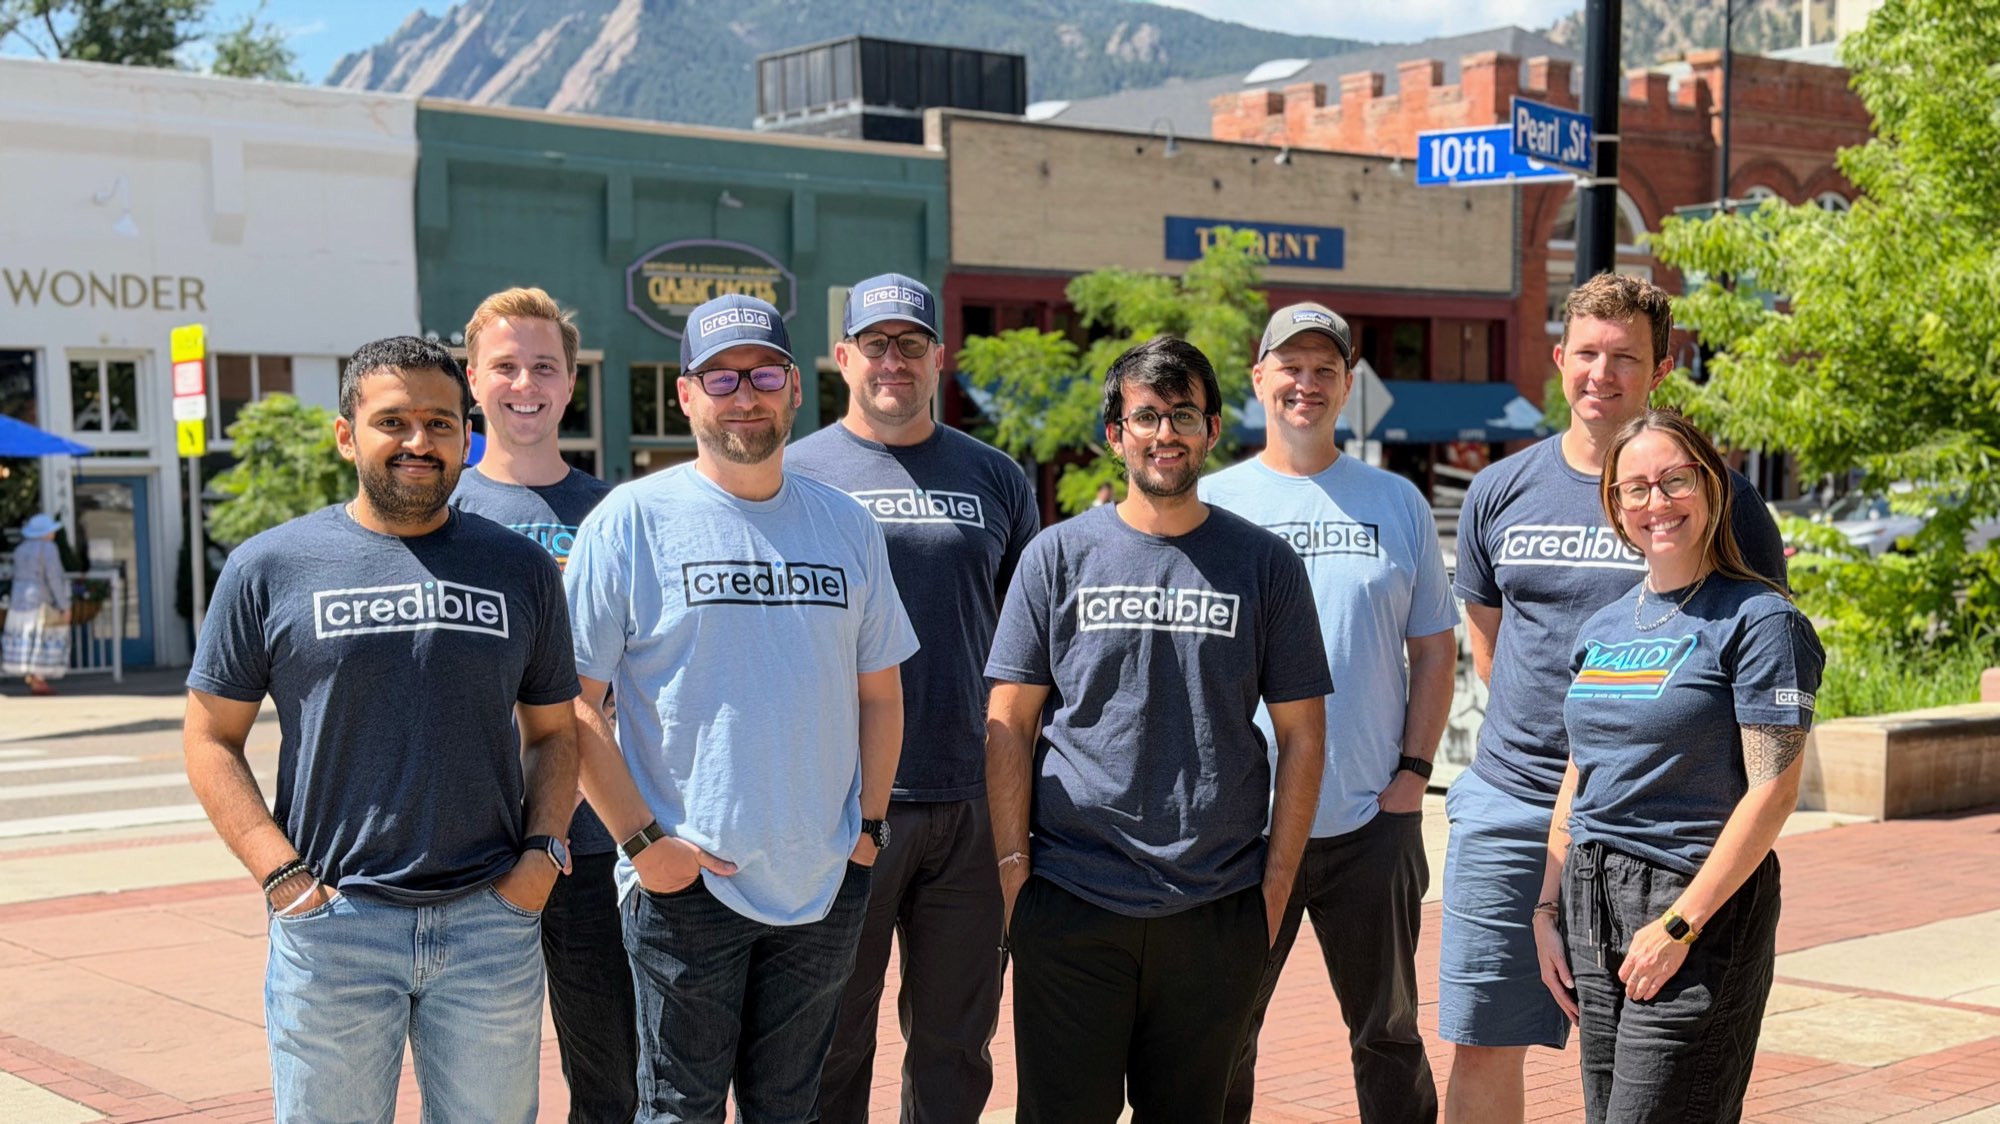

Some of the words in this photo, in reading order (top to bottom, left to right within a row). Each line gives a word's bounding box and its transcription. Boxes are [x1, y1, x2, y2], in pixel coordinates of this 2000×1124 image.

[1517, 107, 1560, 155] Pearl
[1430, 136, 1496, 177] 10th
[1194, 226, 1320, 260] TDENT
[3, 267, 207, 312] WONDER
[866, 286, 922, 305] credible
[704, 307, 768, 332] credible
[863, 488, 976, 519] redible
[694, 560, 841, 597] credible
[325, 581, 500, 626] credible
[1086, 587, 1230, 626] credible
[1586, 645, 1675, 670] MALLOY
